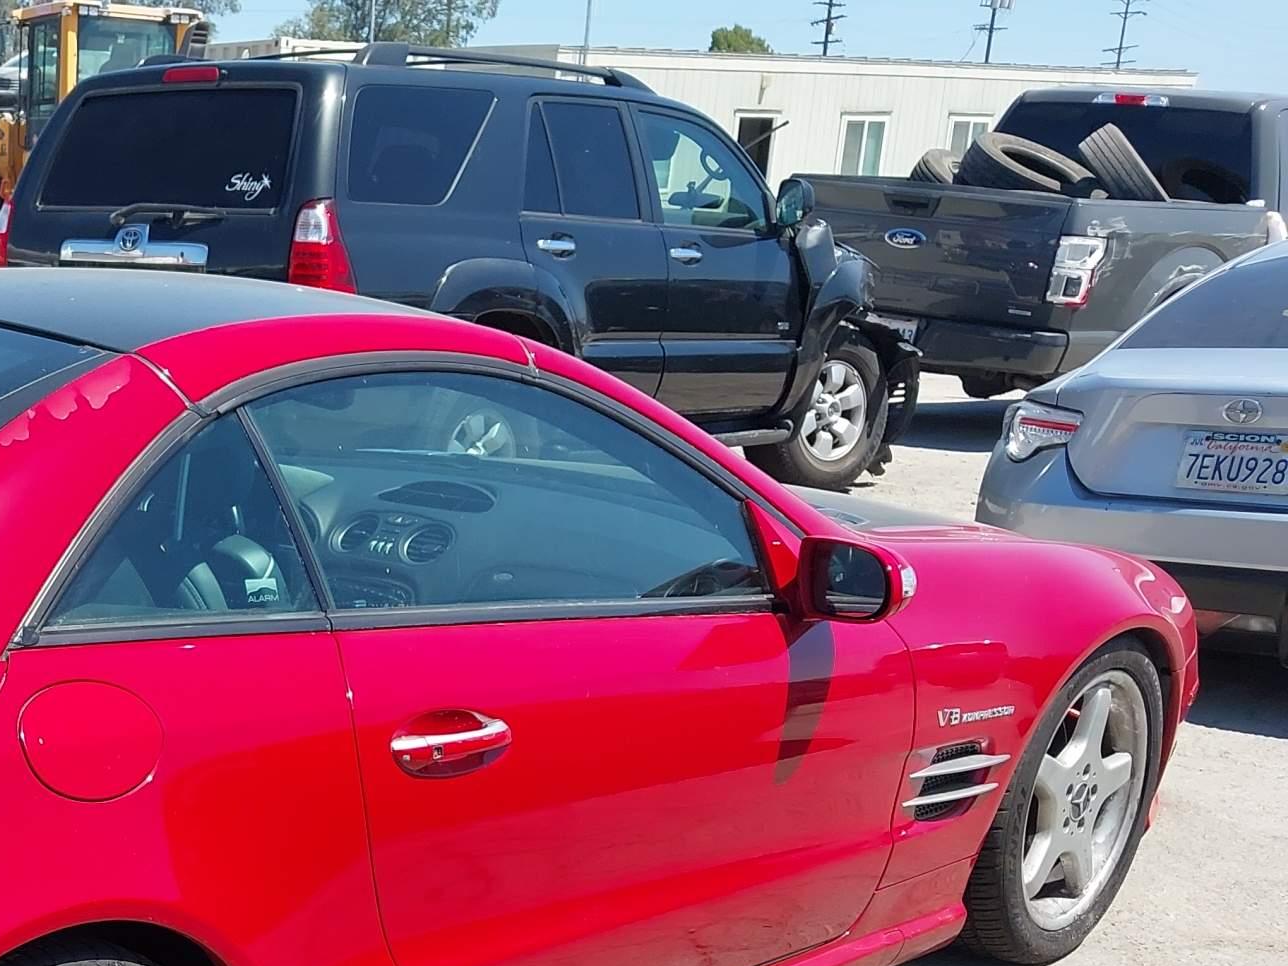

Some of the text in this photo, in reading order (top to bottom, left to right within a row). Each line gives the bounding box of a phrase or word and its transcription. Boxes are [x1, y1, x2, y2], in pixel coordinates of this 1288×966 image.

[225, 172, 264, 201] Shiny
[893, 231, 917, 245] Ford
[1213, 432, 1275, 444] SCION
[1207, 440, 1280, 455] California
[1186, 453, 1288, 485] 7EKU928
[248, 594, 279, 603] ALARM
